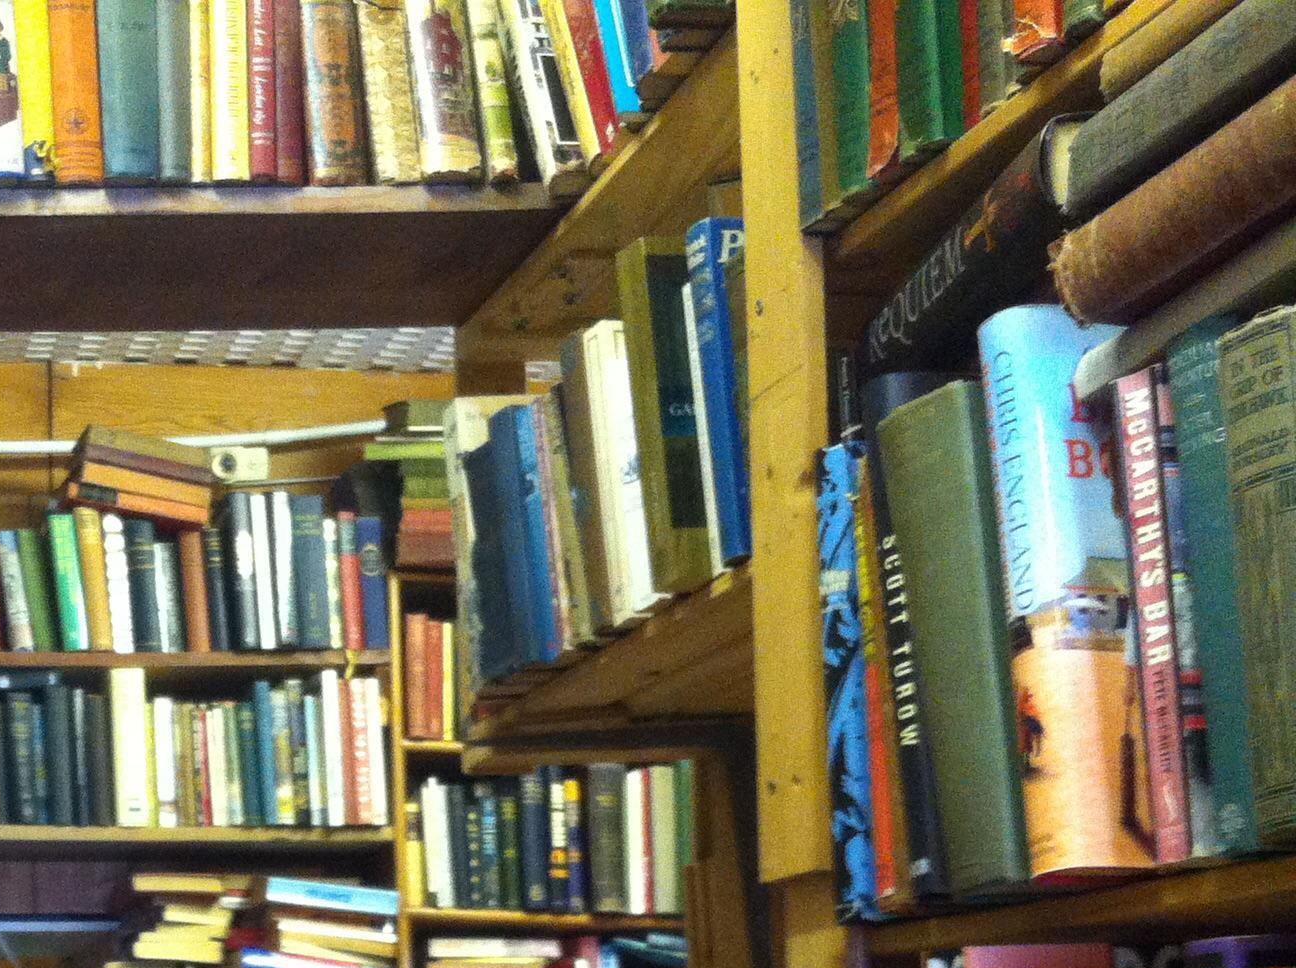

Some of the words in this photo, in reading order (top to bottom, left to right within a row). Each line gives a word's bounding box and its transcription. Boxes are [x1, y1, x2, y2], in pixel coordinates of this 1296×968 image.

[991, 349, 1019, 447] CHRIS
[1003, 453, 1035, 612] ENGLAND
[1123, 386, 1166, 589] McCARTHY'S
[882, 533, 910, 625] SCOTT
[1144, 599, 1176, 667] BAR
[891, 641, 921, 747] TUROW
